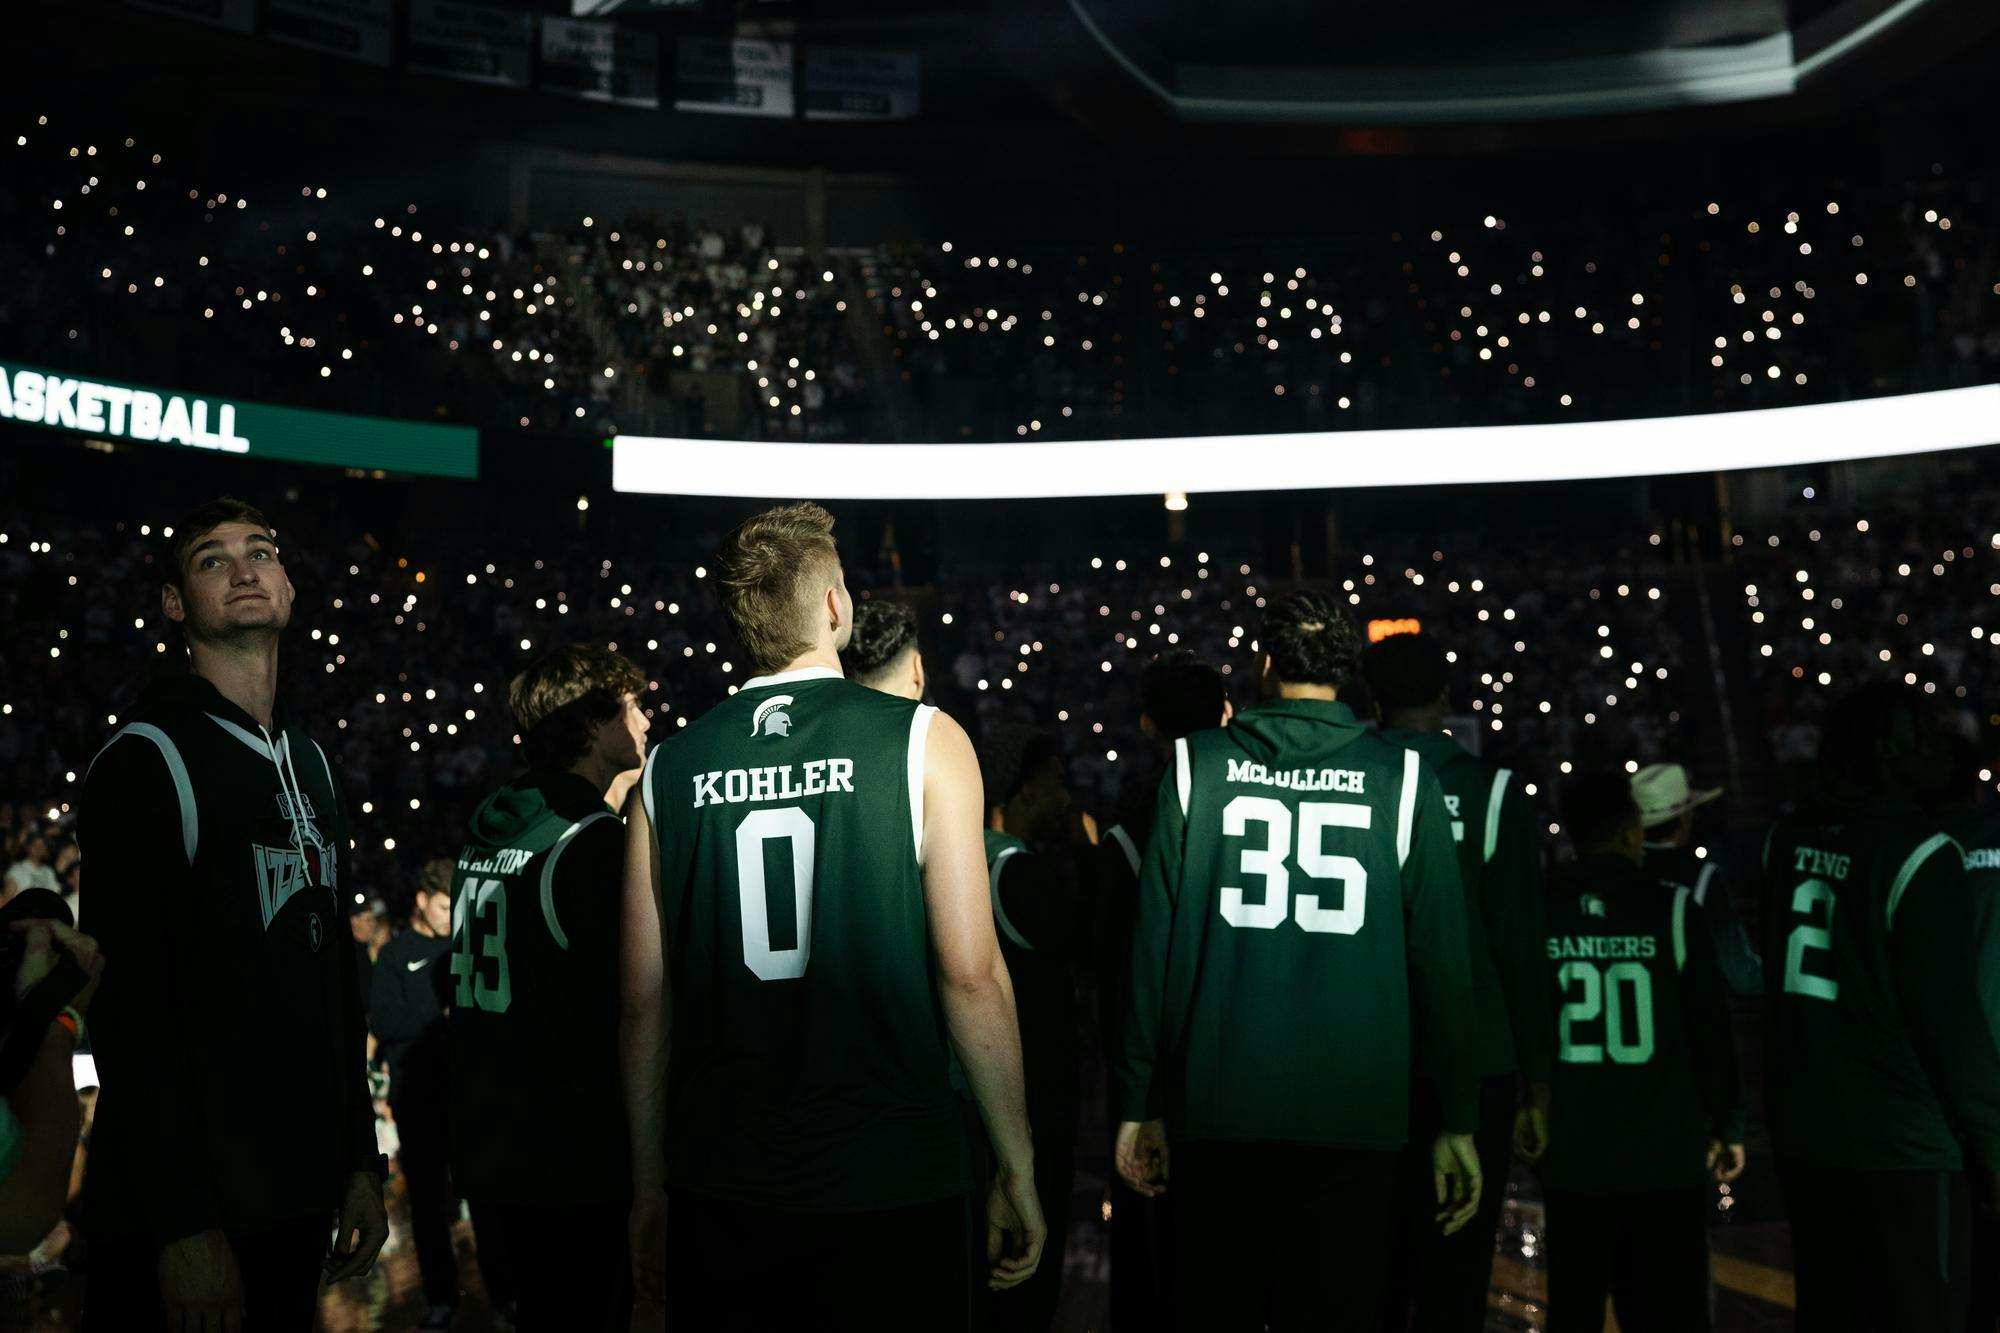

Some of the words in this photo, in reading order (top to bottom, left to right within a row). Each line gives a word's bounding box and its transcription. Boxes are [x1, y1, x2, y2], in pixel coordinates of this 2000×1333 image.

[692, 758, 855, 808] KOHLER
[735, 806, 815, 982] 0
[1219, 795, 1372, 936] 35
[450, 876, 512, 1013] 43
[1546, 935, 1657, 959] SANDERS
[1782, 878, 1839, 1002] 2
[1557, 960, 1656, 1065] 20
